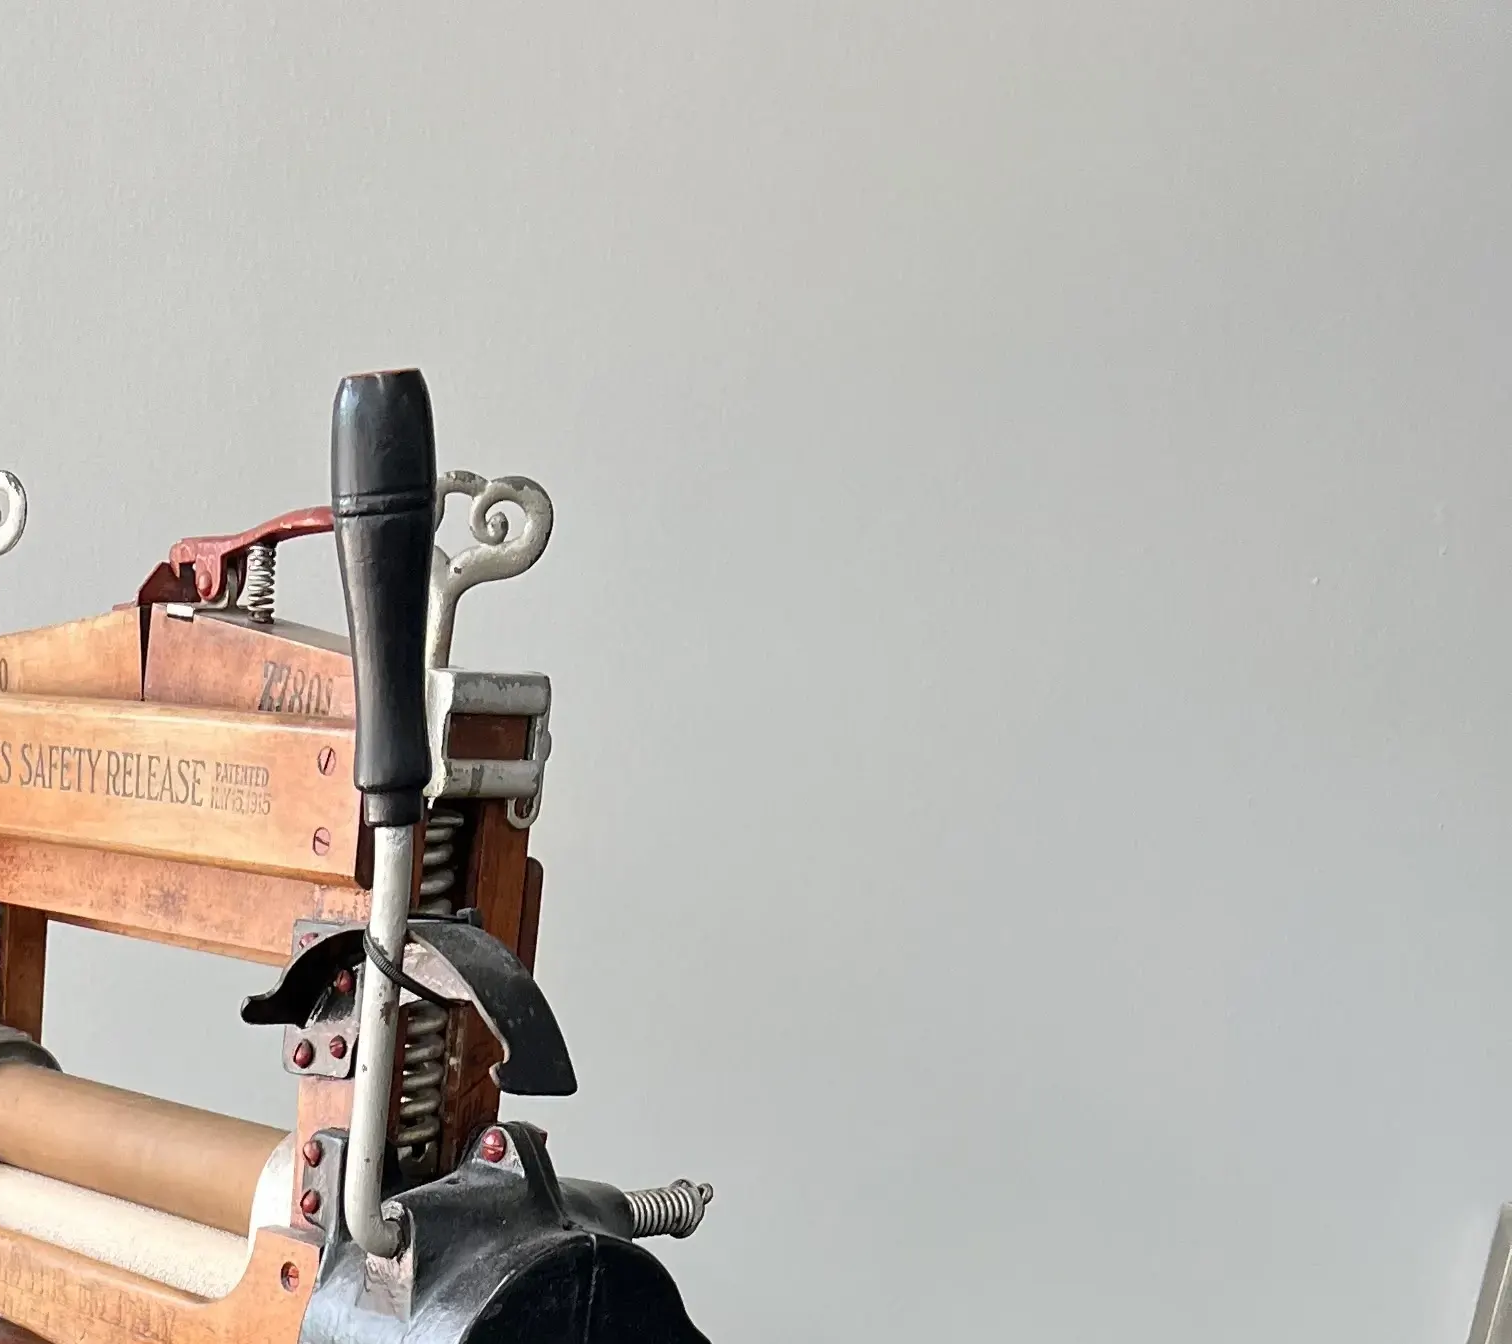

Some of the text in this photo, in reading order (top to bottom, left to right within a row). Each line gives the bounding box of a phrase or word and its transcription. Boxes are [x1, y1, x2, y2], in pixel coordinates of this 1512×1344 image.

[19, 742, 102, 794] SAFETY
[106, 750, 206, 807] RELEASE
[215, 761, 270, 787] PATENTED
